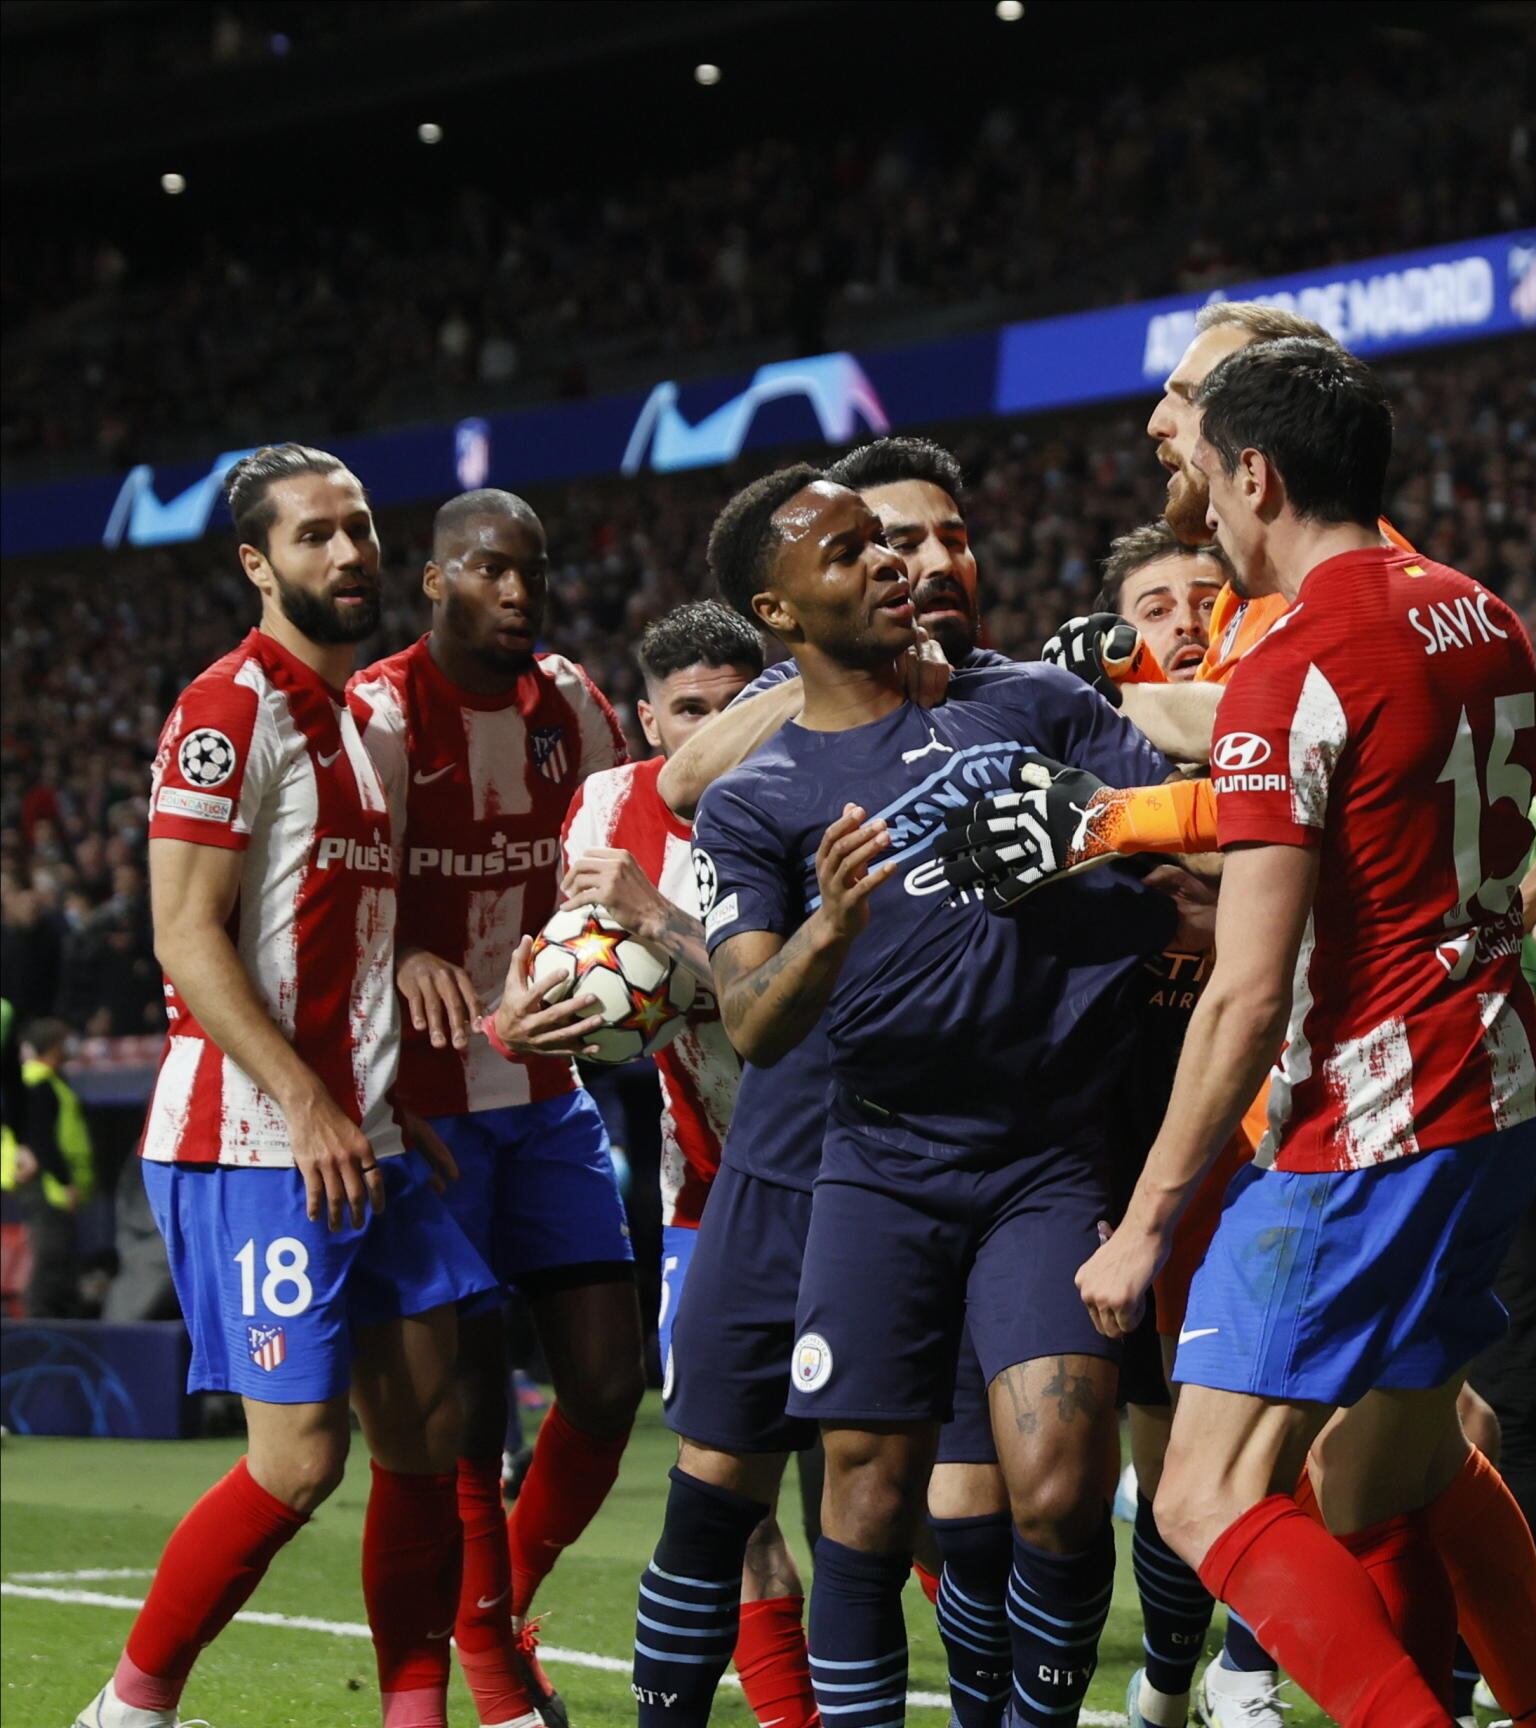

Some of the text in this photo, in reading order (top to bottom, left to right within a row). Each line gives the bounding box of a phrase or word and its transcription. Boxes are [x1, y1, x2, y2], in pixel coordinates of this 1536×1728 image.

[1351, 256, 1494, 341] MADRID
[1435, 691, 1535, 928] 15
[316, 837, 393, 873] Plus5
[408, 837, 558, 876] Plus50
[234, 1236, 313, 1317] 18
[630, 1683, 678, 1707] CITY
